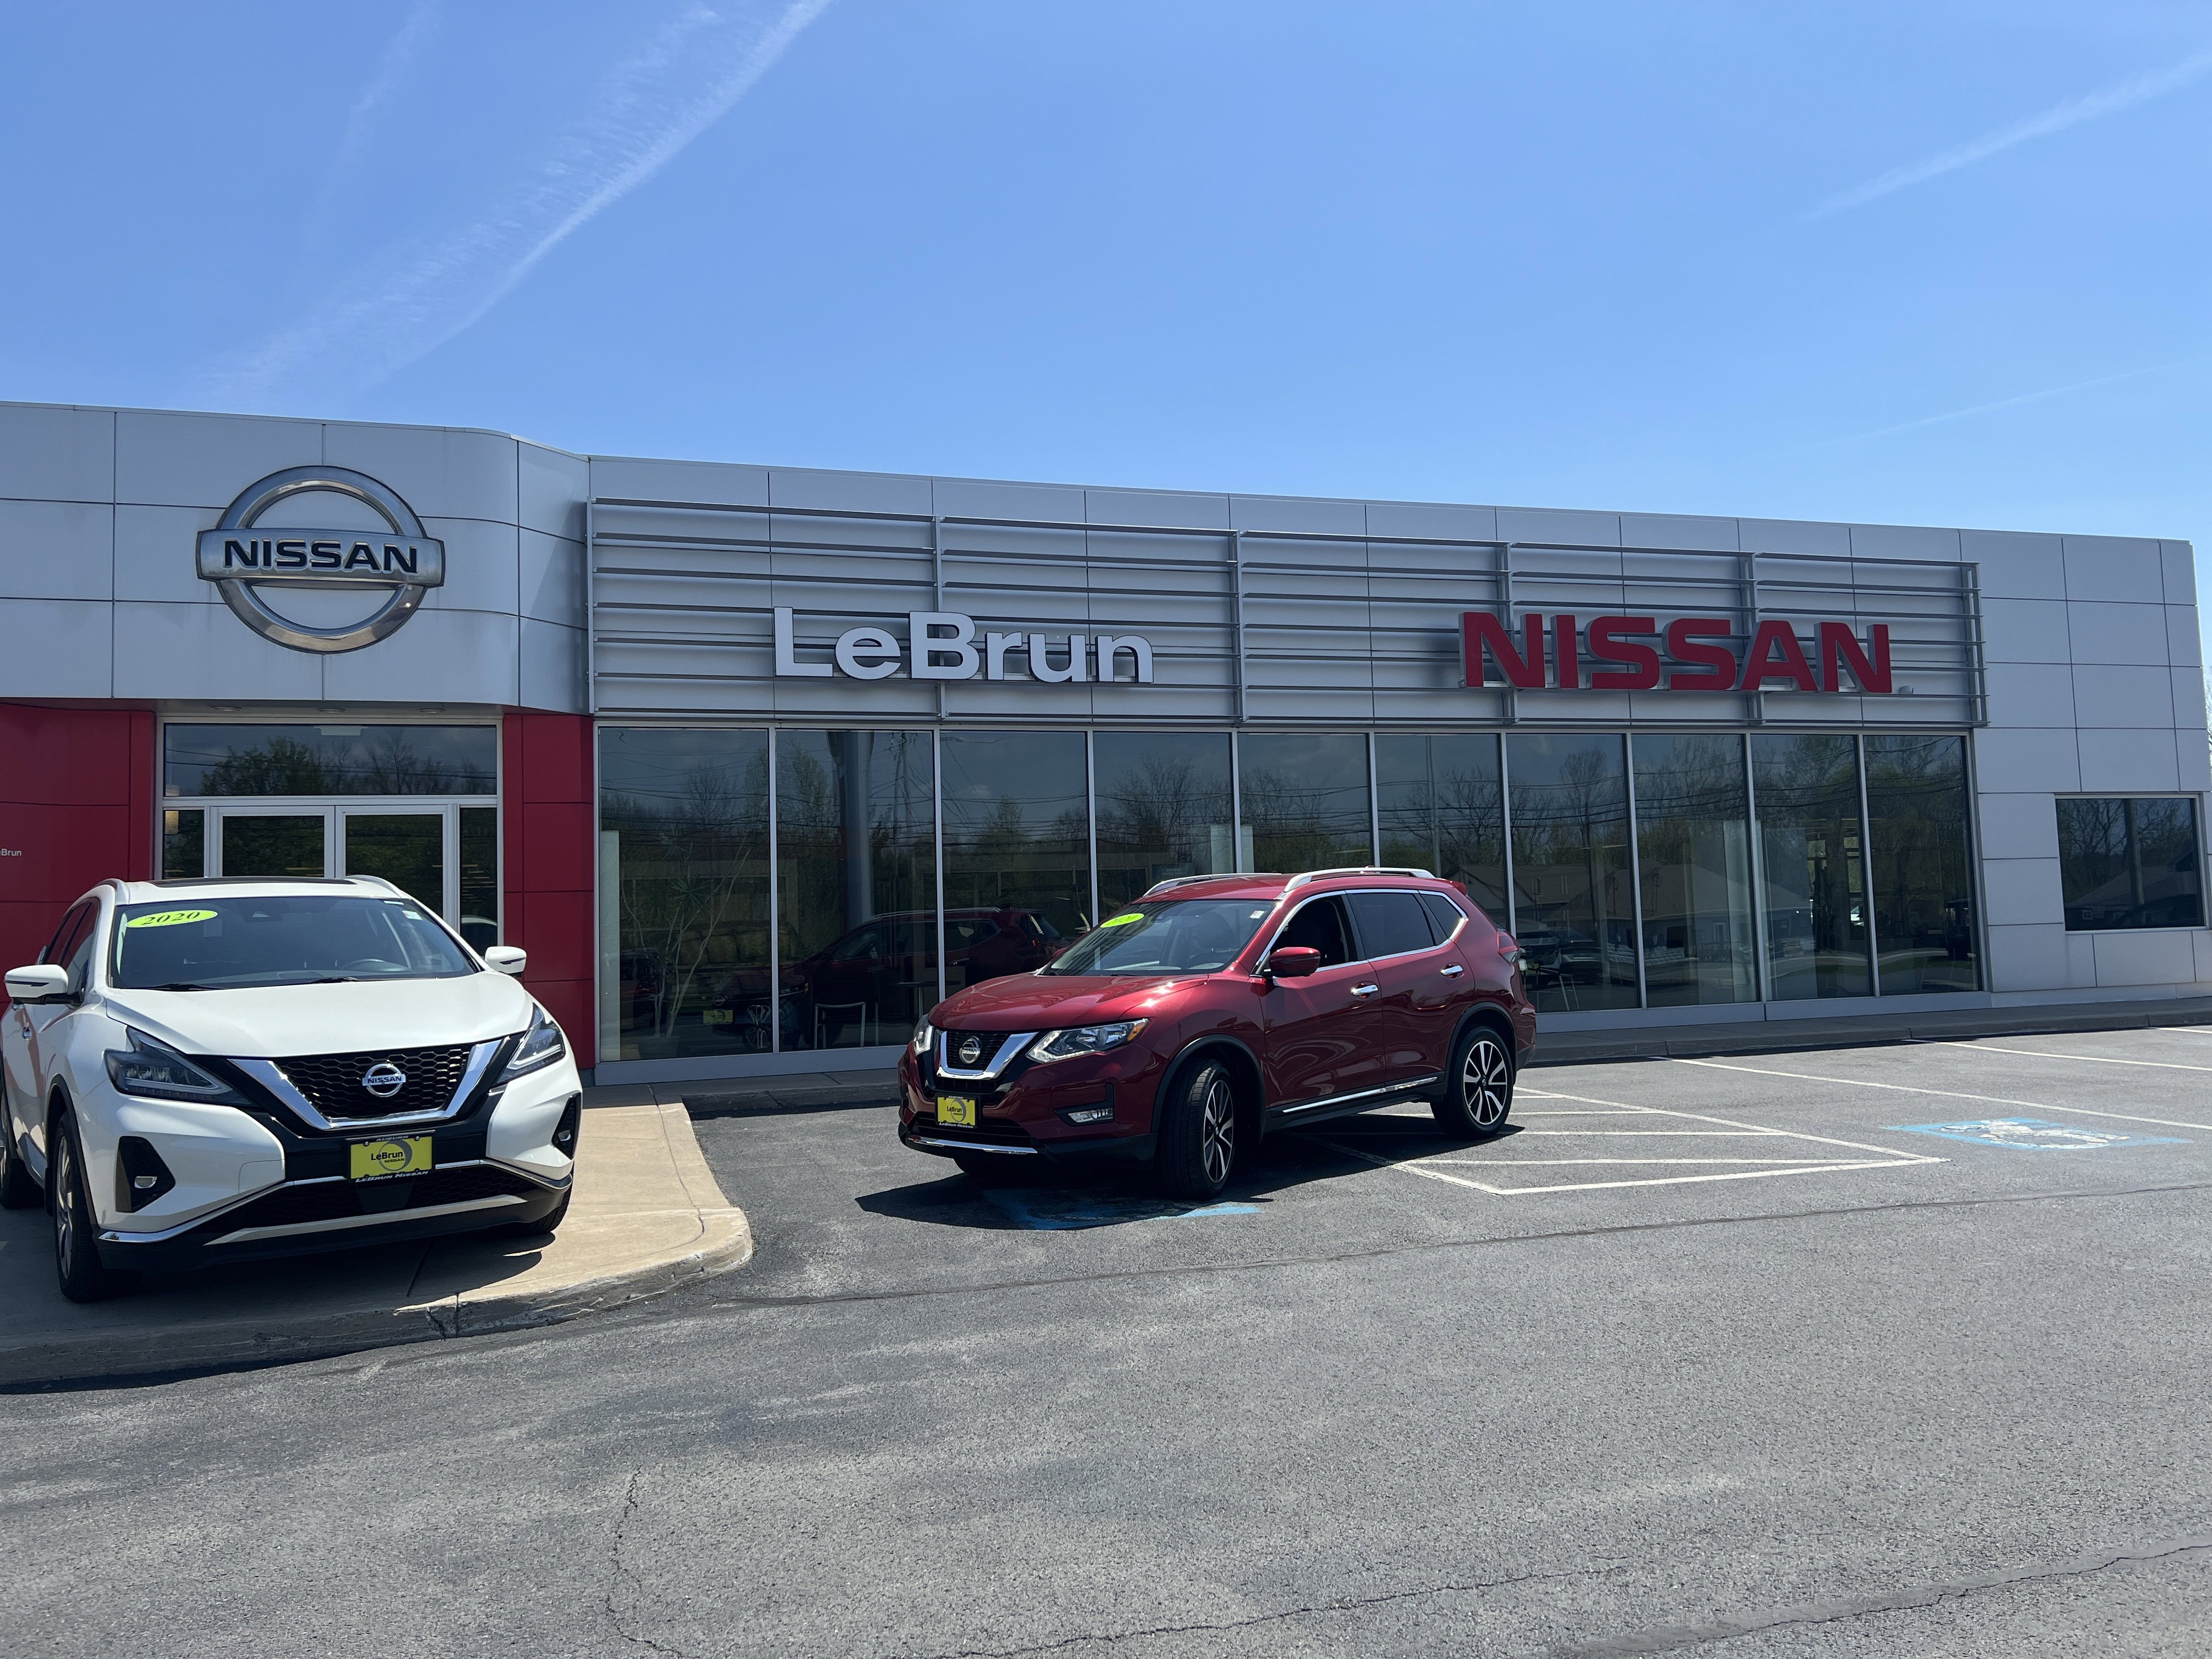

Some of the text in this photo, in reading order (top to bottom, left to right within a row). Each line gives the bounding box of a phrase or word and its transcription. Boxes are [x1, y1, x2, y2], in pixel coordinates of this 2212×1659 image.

[223, 538, 419, 574] NISSAN
[774, 607, 1154, 683] LeBrun
[1459, 612, 1892, 693] NISSAN
[140, 911, 201, 926] 2020
[368, 1076, 402, 1084] NISSAN
[370, 1152, 403, 1161] LeBrun
